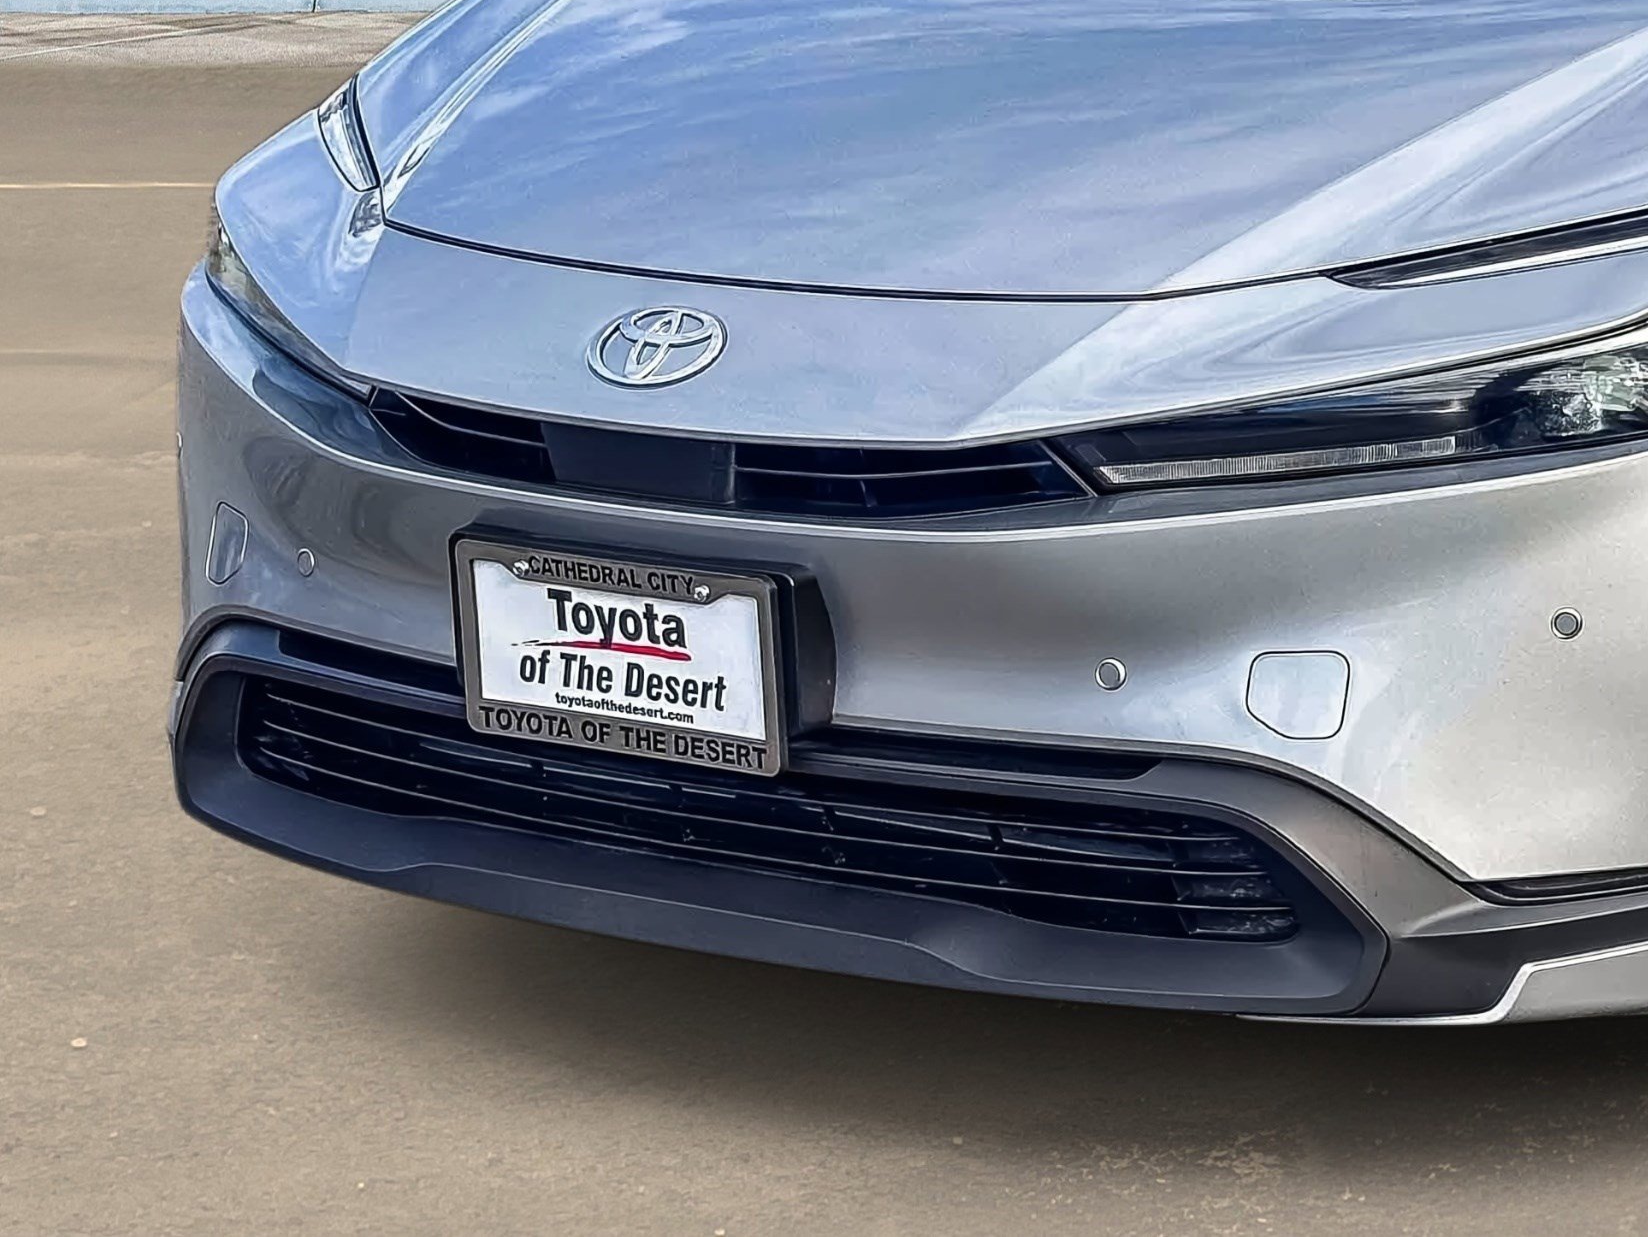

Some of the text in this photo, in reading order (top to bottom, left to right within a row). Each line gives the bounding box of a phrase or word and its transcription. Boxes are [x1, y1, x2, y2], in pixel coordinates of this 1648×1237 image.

[528, 556, 695, 594] CATHEDRAL CITY
[547, 587, 688, 649] Toyota
[519, 650, 727, 711] of The Desert
[555, 692, 694, 724] toyotaofthedesert.com
[478, 706, 768, 769] TOYOTA OF THE DESERT
